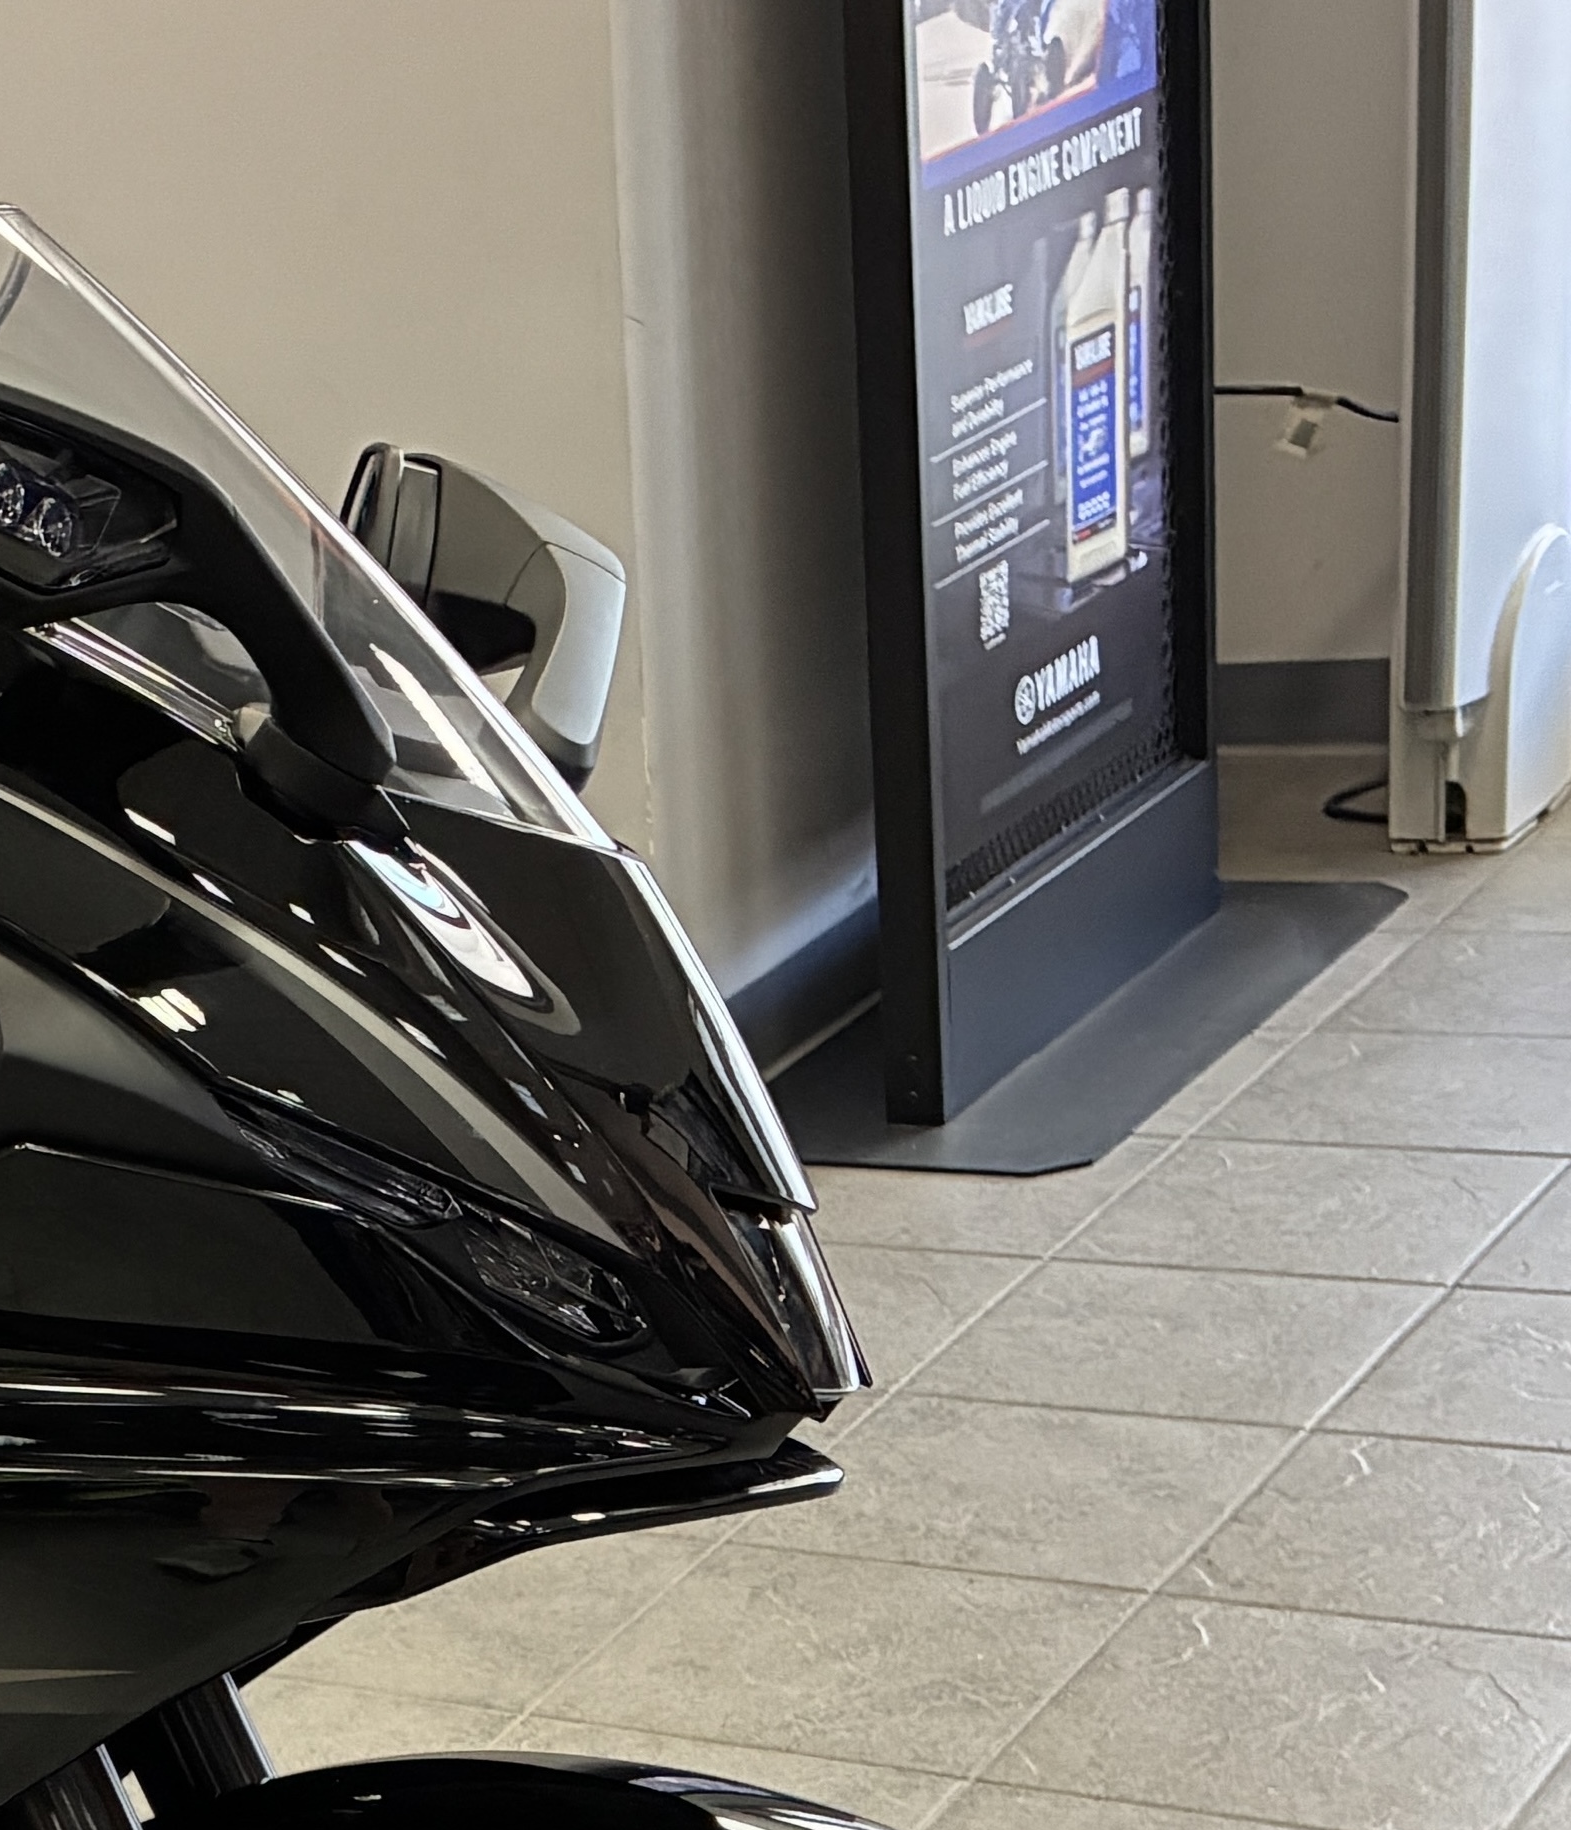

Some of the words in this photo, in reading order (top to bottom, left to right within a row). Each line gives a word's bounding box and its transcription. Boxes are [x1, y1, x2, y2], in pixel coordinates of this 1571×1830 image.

[943, 194, 957, 236] A
[957, 170, 1007, 230] LIQUID
[1009, 144, 1061, 206] ENGINE
[1062, 106, 1143, 181] COMPONENT
[1033, 634, 1100, 712] YAMAHA
